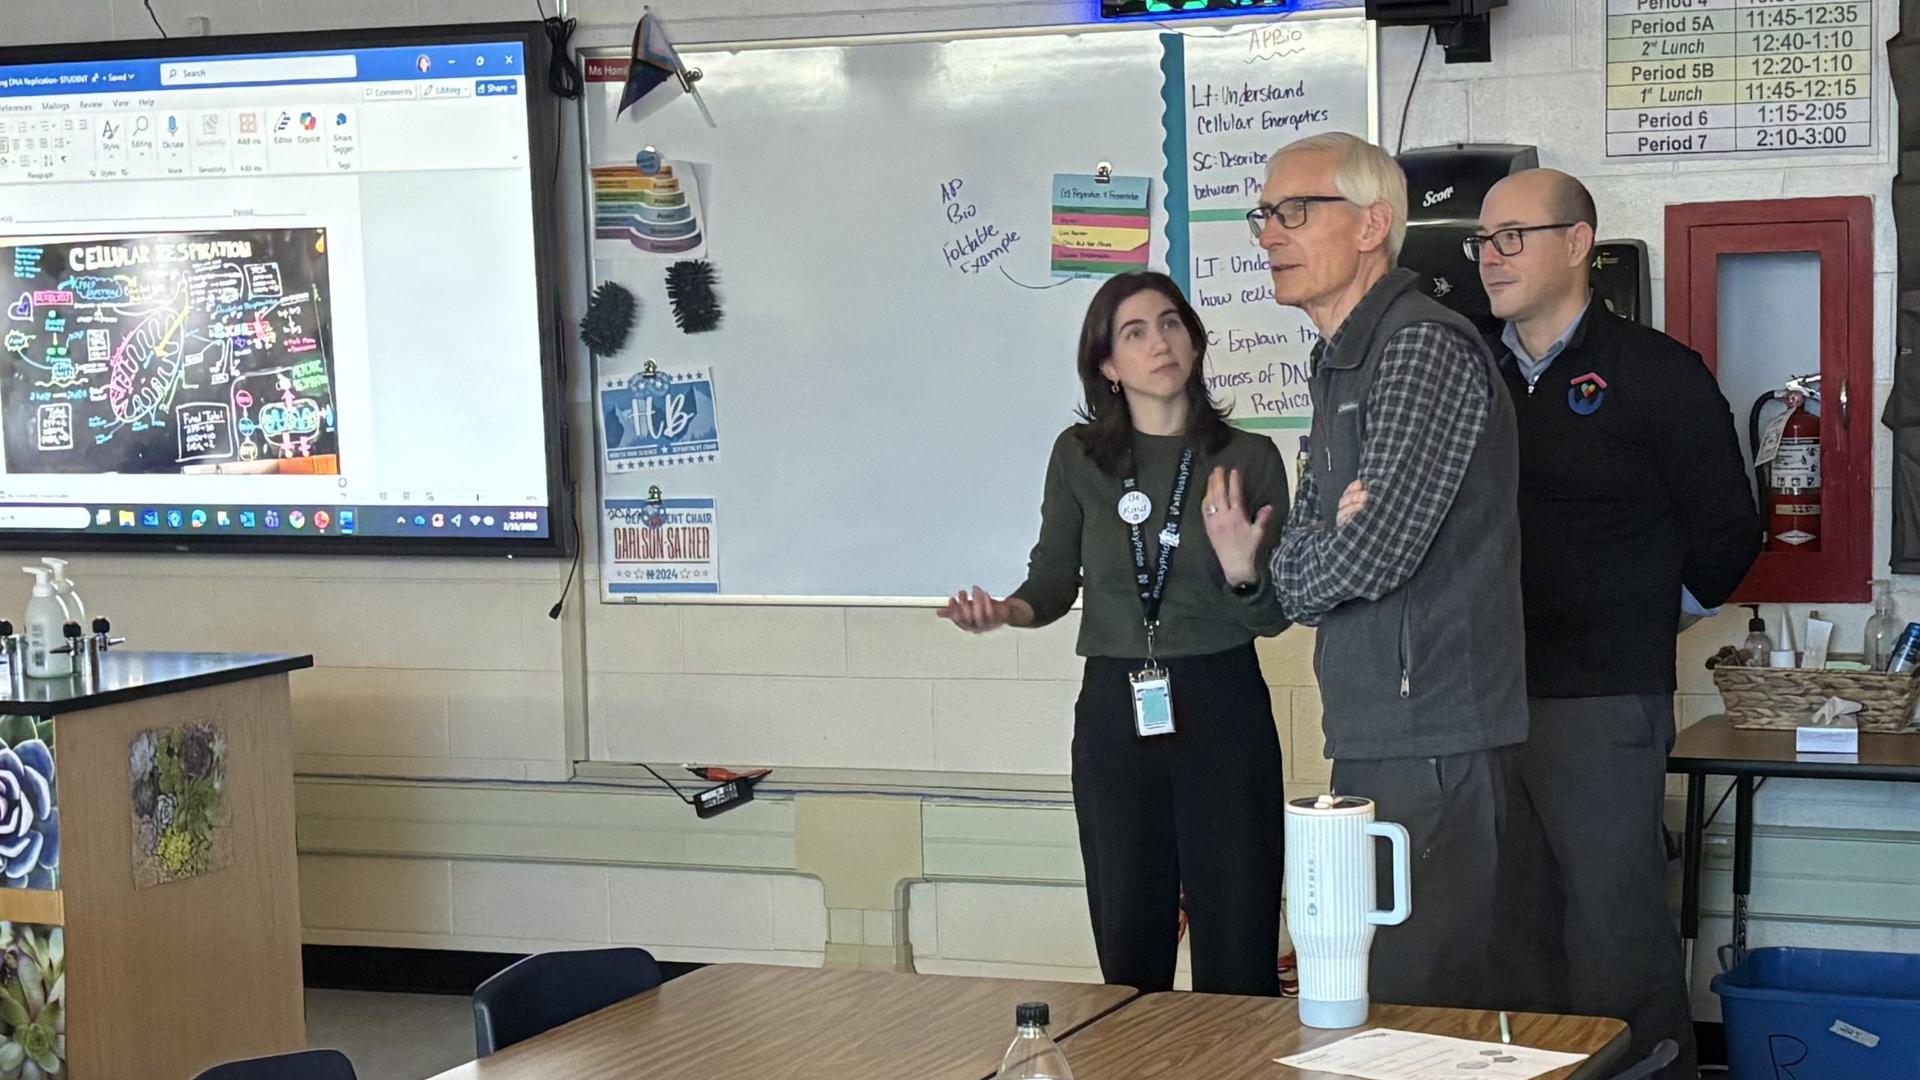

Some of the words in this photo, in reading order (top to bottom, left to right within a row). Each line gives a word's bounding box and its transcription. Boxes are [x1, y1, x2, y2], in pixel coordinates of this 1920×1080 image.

[1631, 17, 1686, 35] Period
[1692, 15, 1715, 32] 5A
[1746, 5, 1858, 28] 11:45-12:35
[1661, 39, 1705, 56] Lunch
[1752, 30, 1853, 53] 12:40-1:10
[183, 69, 206, 78] Search
[1631, 64, 1686, 82] Period
[1692, 62, 1714, 79] 5B
[1752, 54, 1853, 76] 12:20-1:10
[375, 88, 412, 98] Comments
[487, 82, 508, 93] Share
[1221, 80, 1305, 107] Understand
[1660, 85, 1703, 103] Lunch
[1745, 78, 1857, 100] 11:45-12:15
[0, 103, 32, 112] eferences
[42, 101, 70, 111] Mailings
[79, 100, 103, 109] Review
[113, 99, 129, 108] View
[139, 97, 154, 107] Help
[1758, 102, 1848, 123] 1:15-2:05
[1197, 115, 1255, 136] Cellular
[1262, 109, 1329, 131] Energetics
[1638, 111, 1693, 129] Period
[1698, 110, 1708, 126] 6
[1638, 136, 1693, 152] Period
[1697, 134, 1708, 150] 7
[1757, 126, 1847, 147] 2:10-3:00
[1219, 151, 1269, 168] Describe
[941, 178, 963, 205] AP
[1193, 183, 1240, 201] between
[1244, 176, 1264, 197] Ph
[946, 202, 976, 224] Bio
[69, 245, 149, 272] CELLULAR
[960, 231, 1021, 274] Example
[1199, 289, 1233, 307] how
[1241, 284, 1275, 304] cells
[1228, 328, 1288, 354] Explain
[1297, 324, 1321, 344] th
[1258, 362, 1276, 384] of
[1280, 360, 1310, 387] DN
[1251, 391, 1311, 414] Replica
[686, 512, 713, 525] CHAIR
[1122, 503, 1148, 516] Kind
[1768, 1033, 1809, 1080] R
